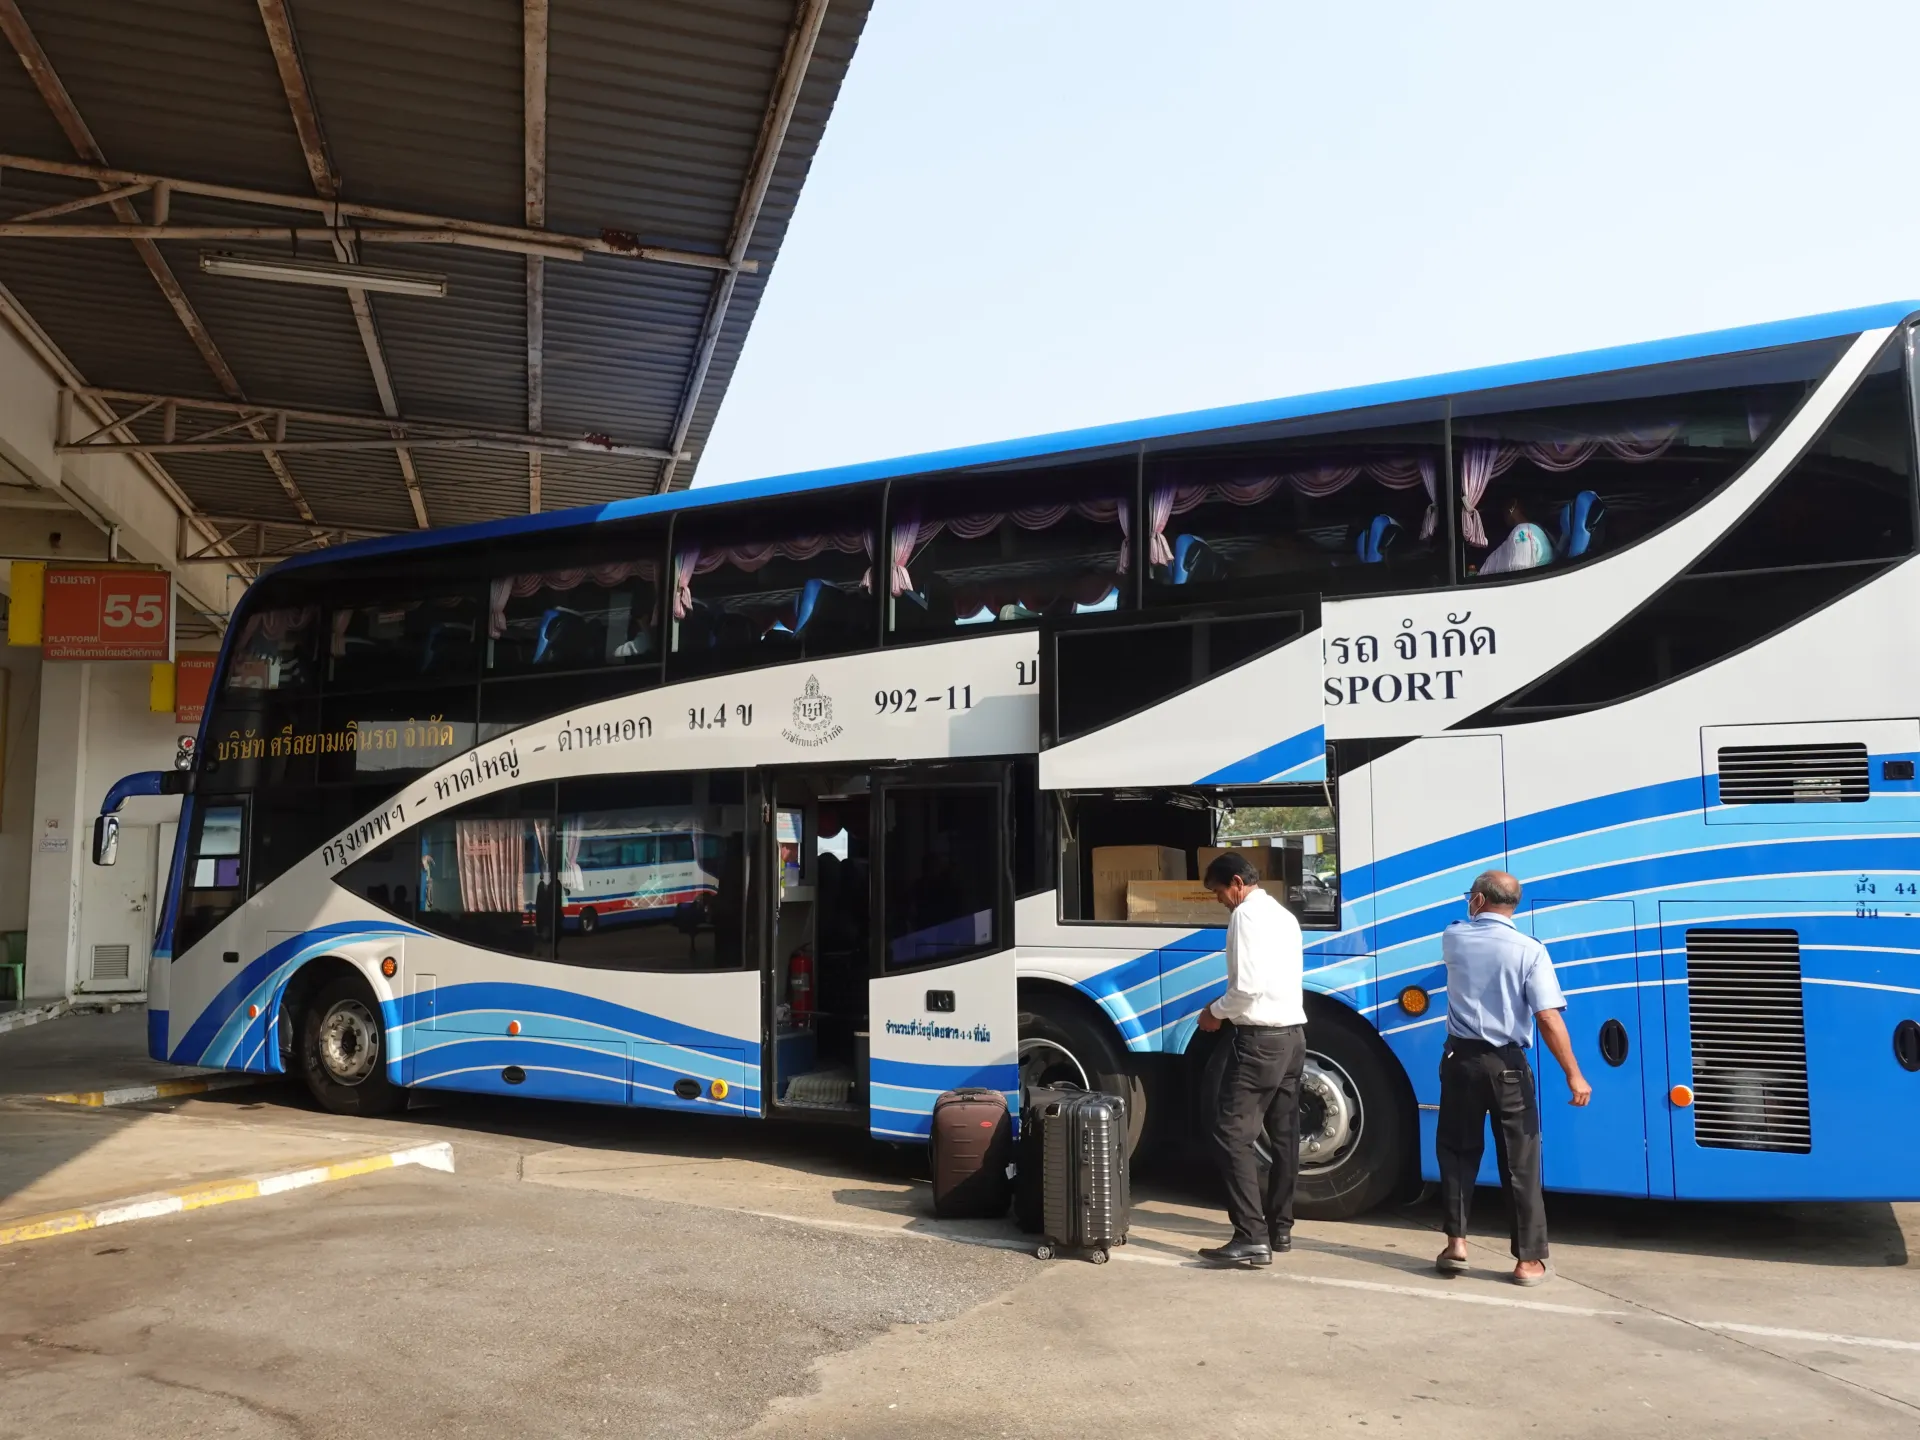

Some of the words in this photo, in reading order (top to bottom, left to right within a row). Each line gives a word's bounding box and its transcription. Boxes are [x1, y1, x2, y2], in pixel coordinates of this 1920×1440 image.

[103, 594, 163, 628] 55
[48, 635, 98, 644] PLATFORM
[1394, 611, 1496, 660] จำกัด
[218, 730, 265, 762] บริษัท
[270, 720, 397, 757] ศรีสยามเดินรถ
[404, 713, 455, 747] จำกัด
[322, 804, 406, 866] กรุงเทพฯ
[433, 740, 520, 800] หาดใหญ่
[557, 712, 653, 753] ด่านนอก
[1894, 882, 1918, 895] 44
